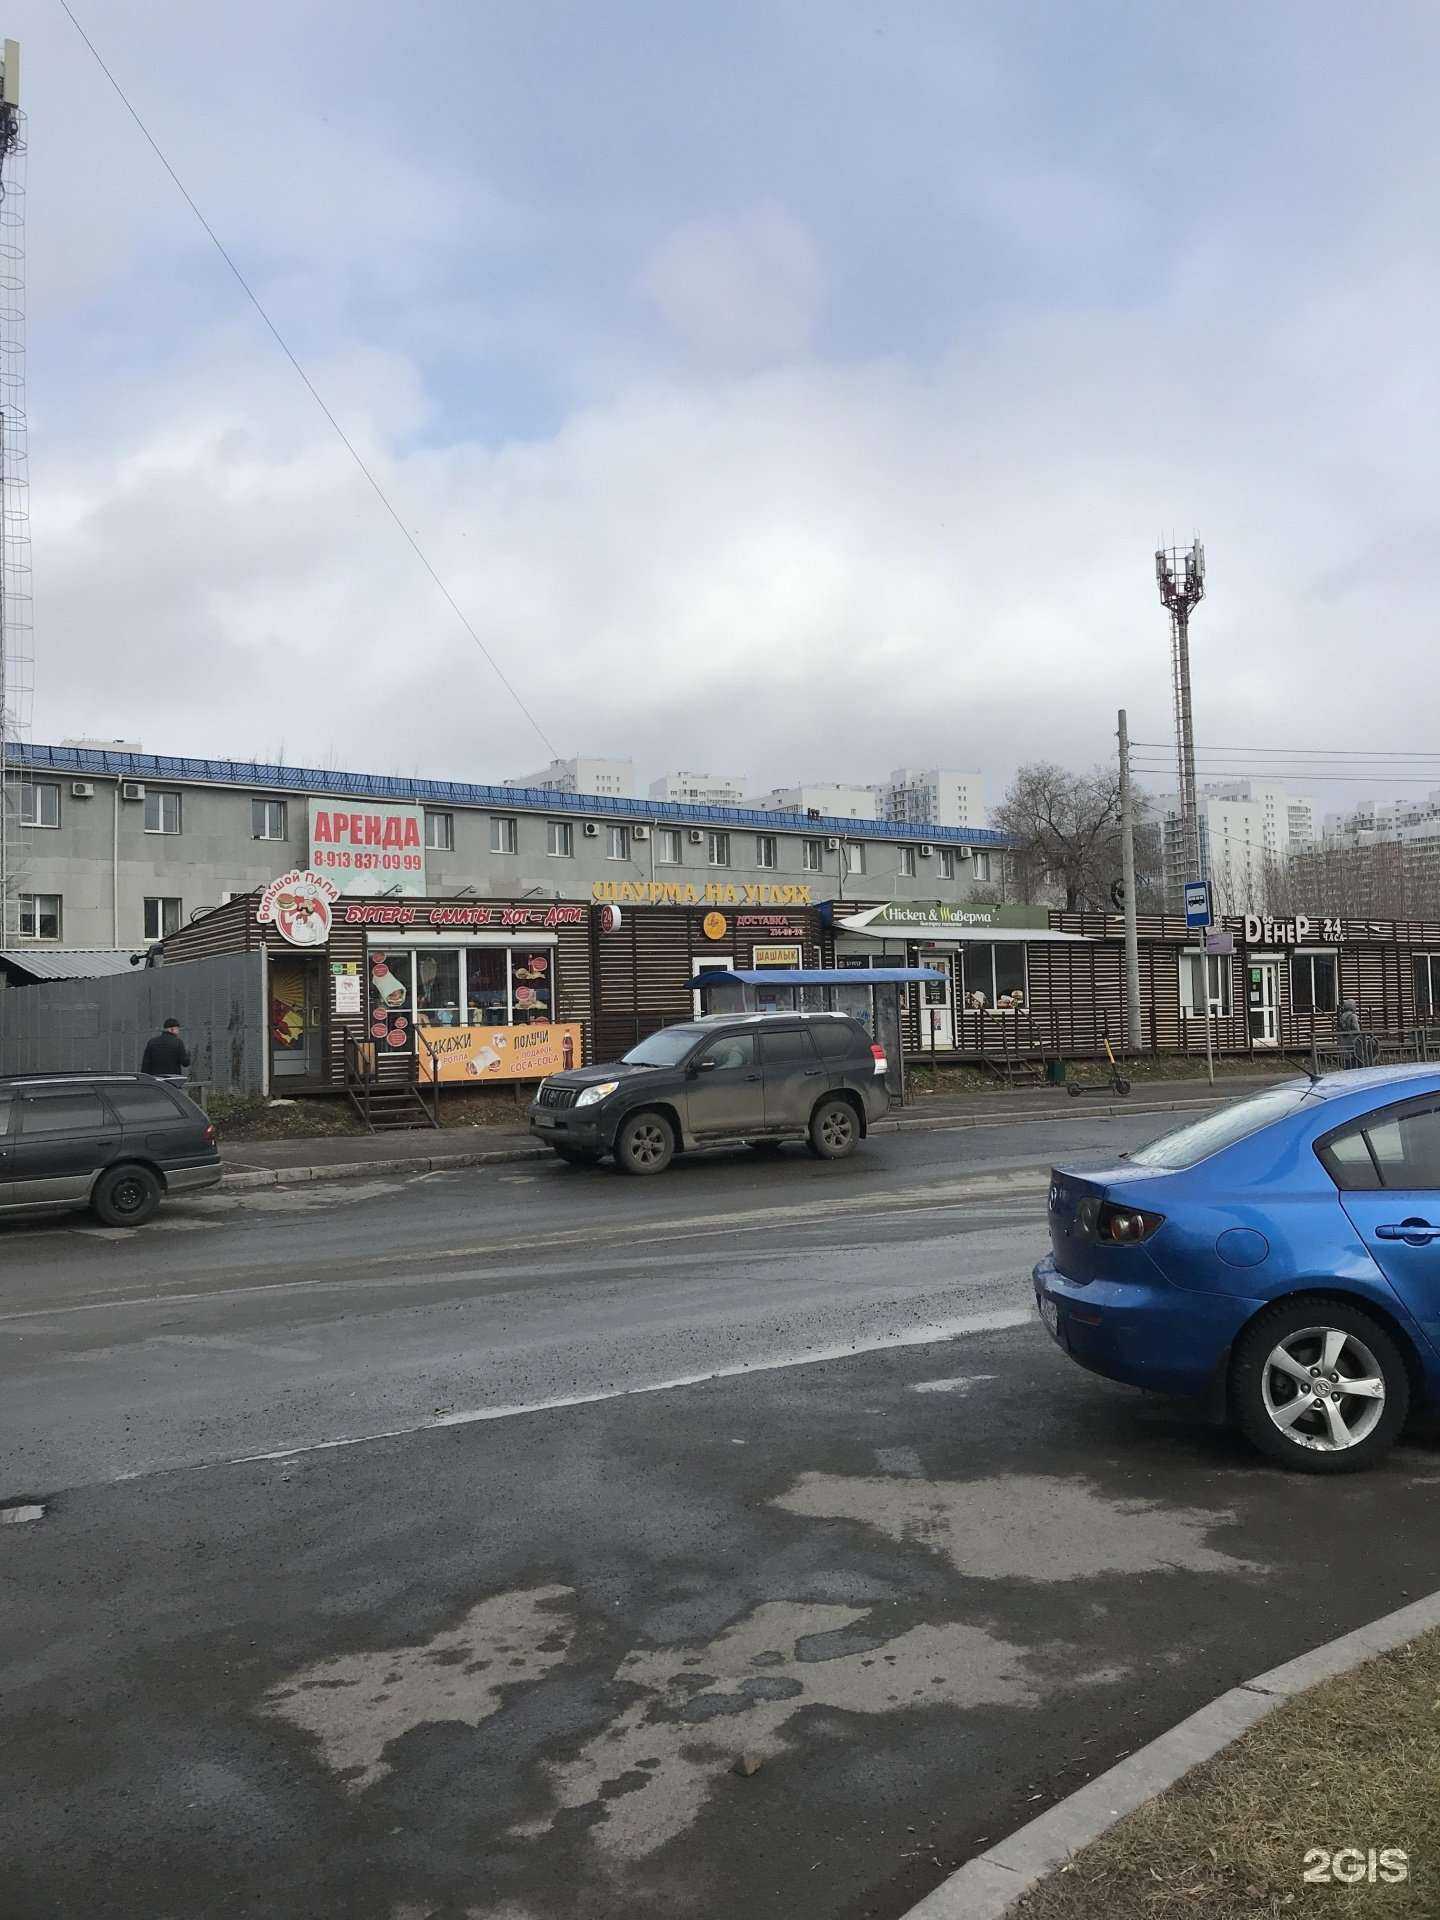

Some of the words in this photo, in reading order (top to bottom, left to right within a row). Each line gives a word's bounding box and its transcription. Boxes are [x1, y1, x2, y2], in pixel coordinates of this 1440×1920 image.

[314, 811, 420, 851] АРЕНДА
[260, 871, 300, 920] БОЛЬШОЙ
[305, 872, 338, 900] ПАПА
[592, 880, 699, 902] ШАУРМА
[705, 881, 736, 902] НА
[746, 884, 812, 904] УГЛЯХ
[345, 906, 416, 923] БУРГЕРЫ
[430, 907, 491, 925] САЛАТЫ
[603, 910, 612, 923] 24
[736, 915, 789, 927] ДОСТАВКА
[928, 908, 938, 921] &
[1323, 918, 1342, 934] 24
[1323, 933, 1345, 942] ЧАСА
[756, 950, 797, 962] ШАШЛЫК
[426, 1033, 472, 1057] ЗАКАЖИ
[514, 1029, 549, 1050] ПОЛУЧИ
